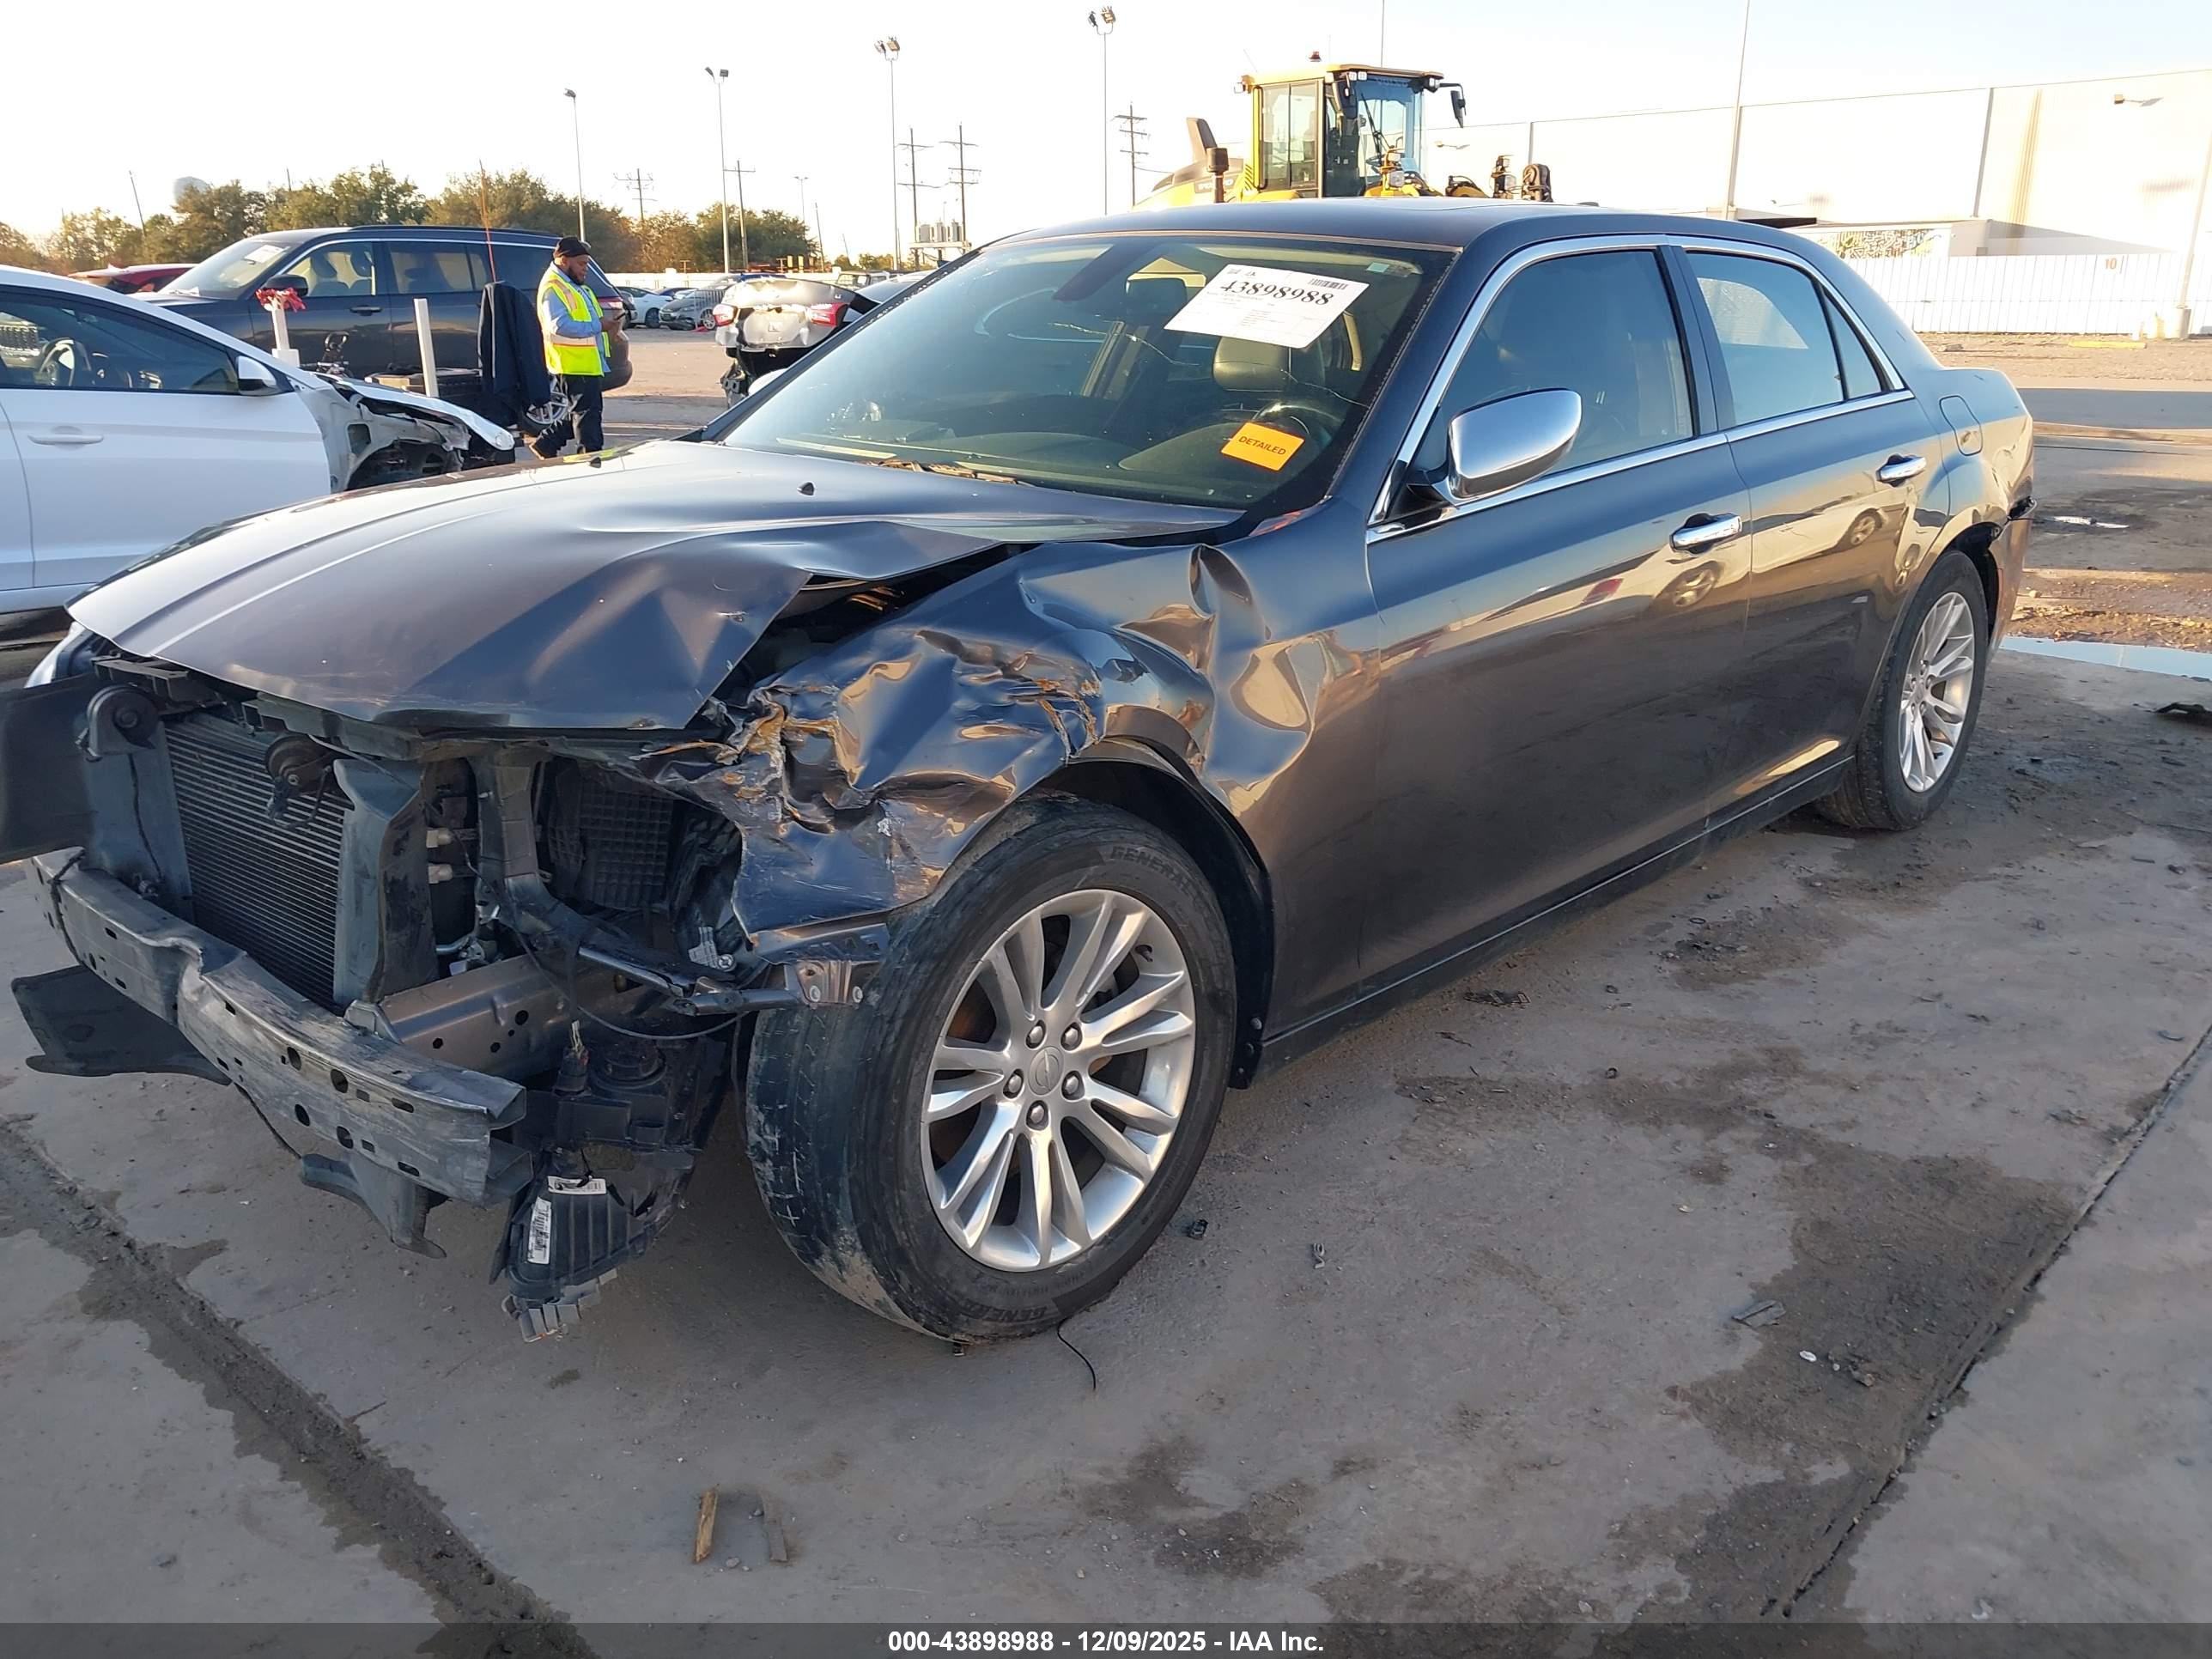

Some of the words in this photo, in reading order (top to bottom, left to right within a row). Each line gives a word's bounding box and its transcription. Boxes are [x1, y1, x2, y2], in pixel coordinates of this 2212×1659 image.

[2105, 258, 2118, 270] 10
[1220, 280, 1334, 306] 43898988
[1238, 435, 1286, 455] DETAILED
